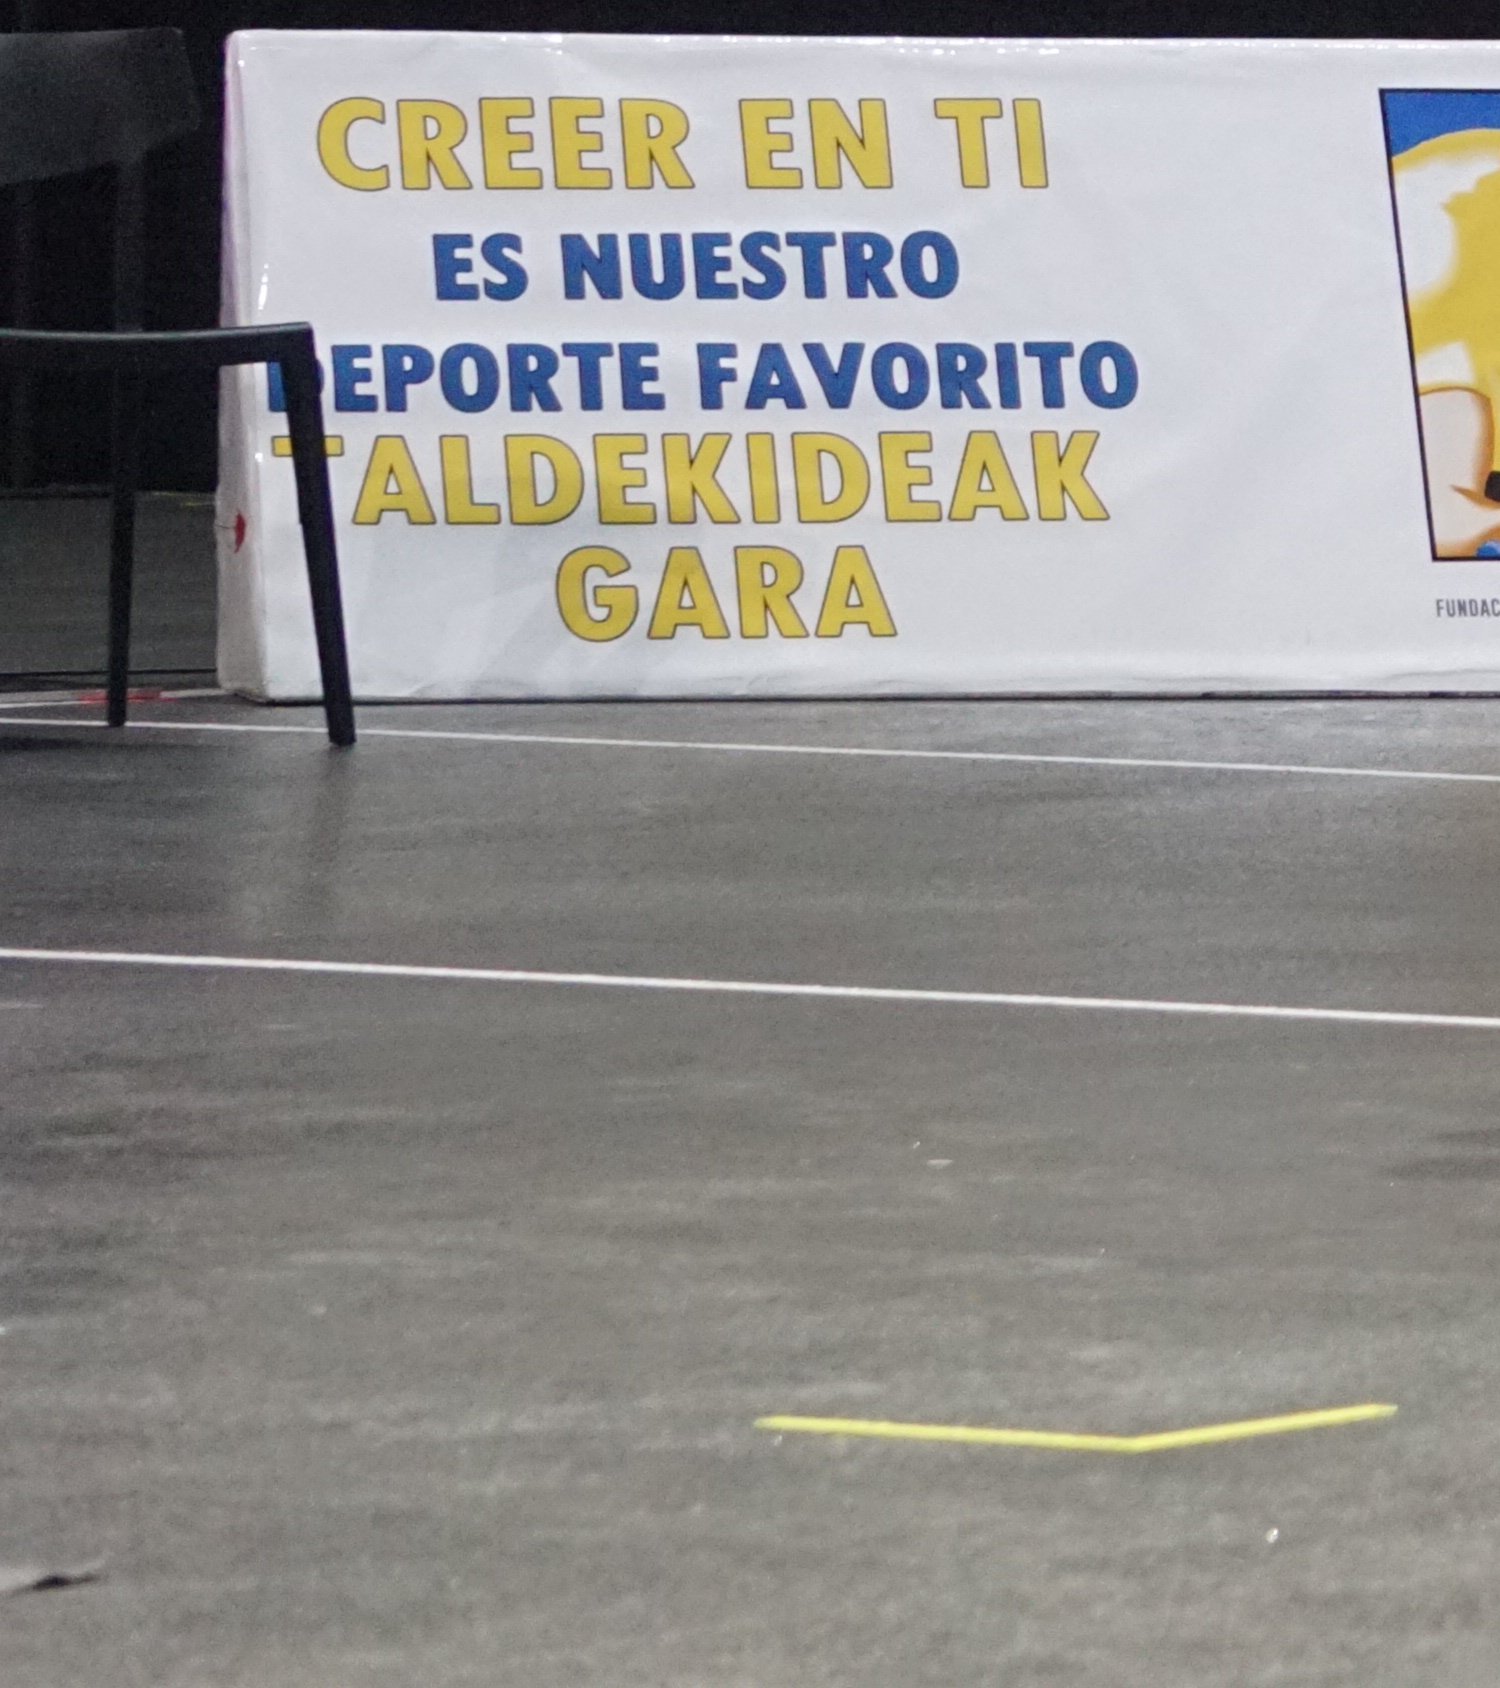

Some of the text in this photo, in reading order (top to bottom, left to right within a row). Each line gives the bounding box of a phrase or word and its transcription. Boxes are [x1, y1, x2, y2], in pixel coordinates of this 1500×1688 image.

[316, 95, 1049, 192] CREER EN TI
[432, 230, 960, 301] ES NUESTRO
[697, 340, 1139, 410] FAVORITO
[555, 545, 896, 642] GARA
